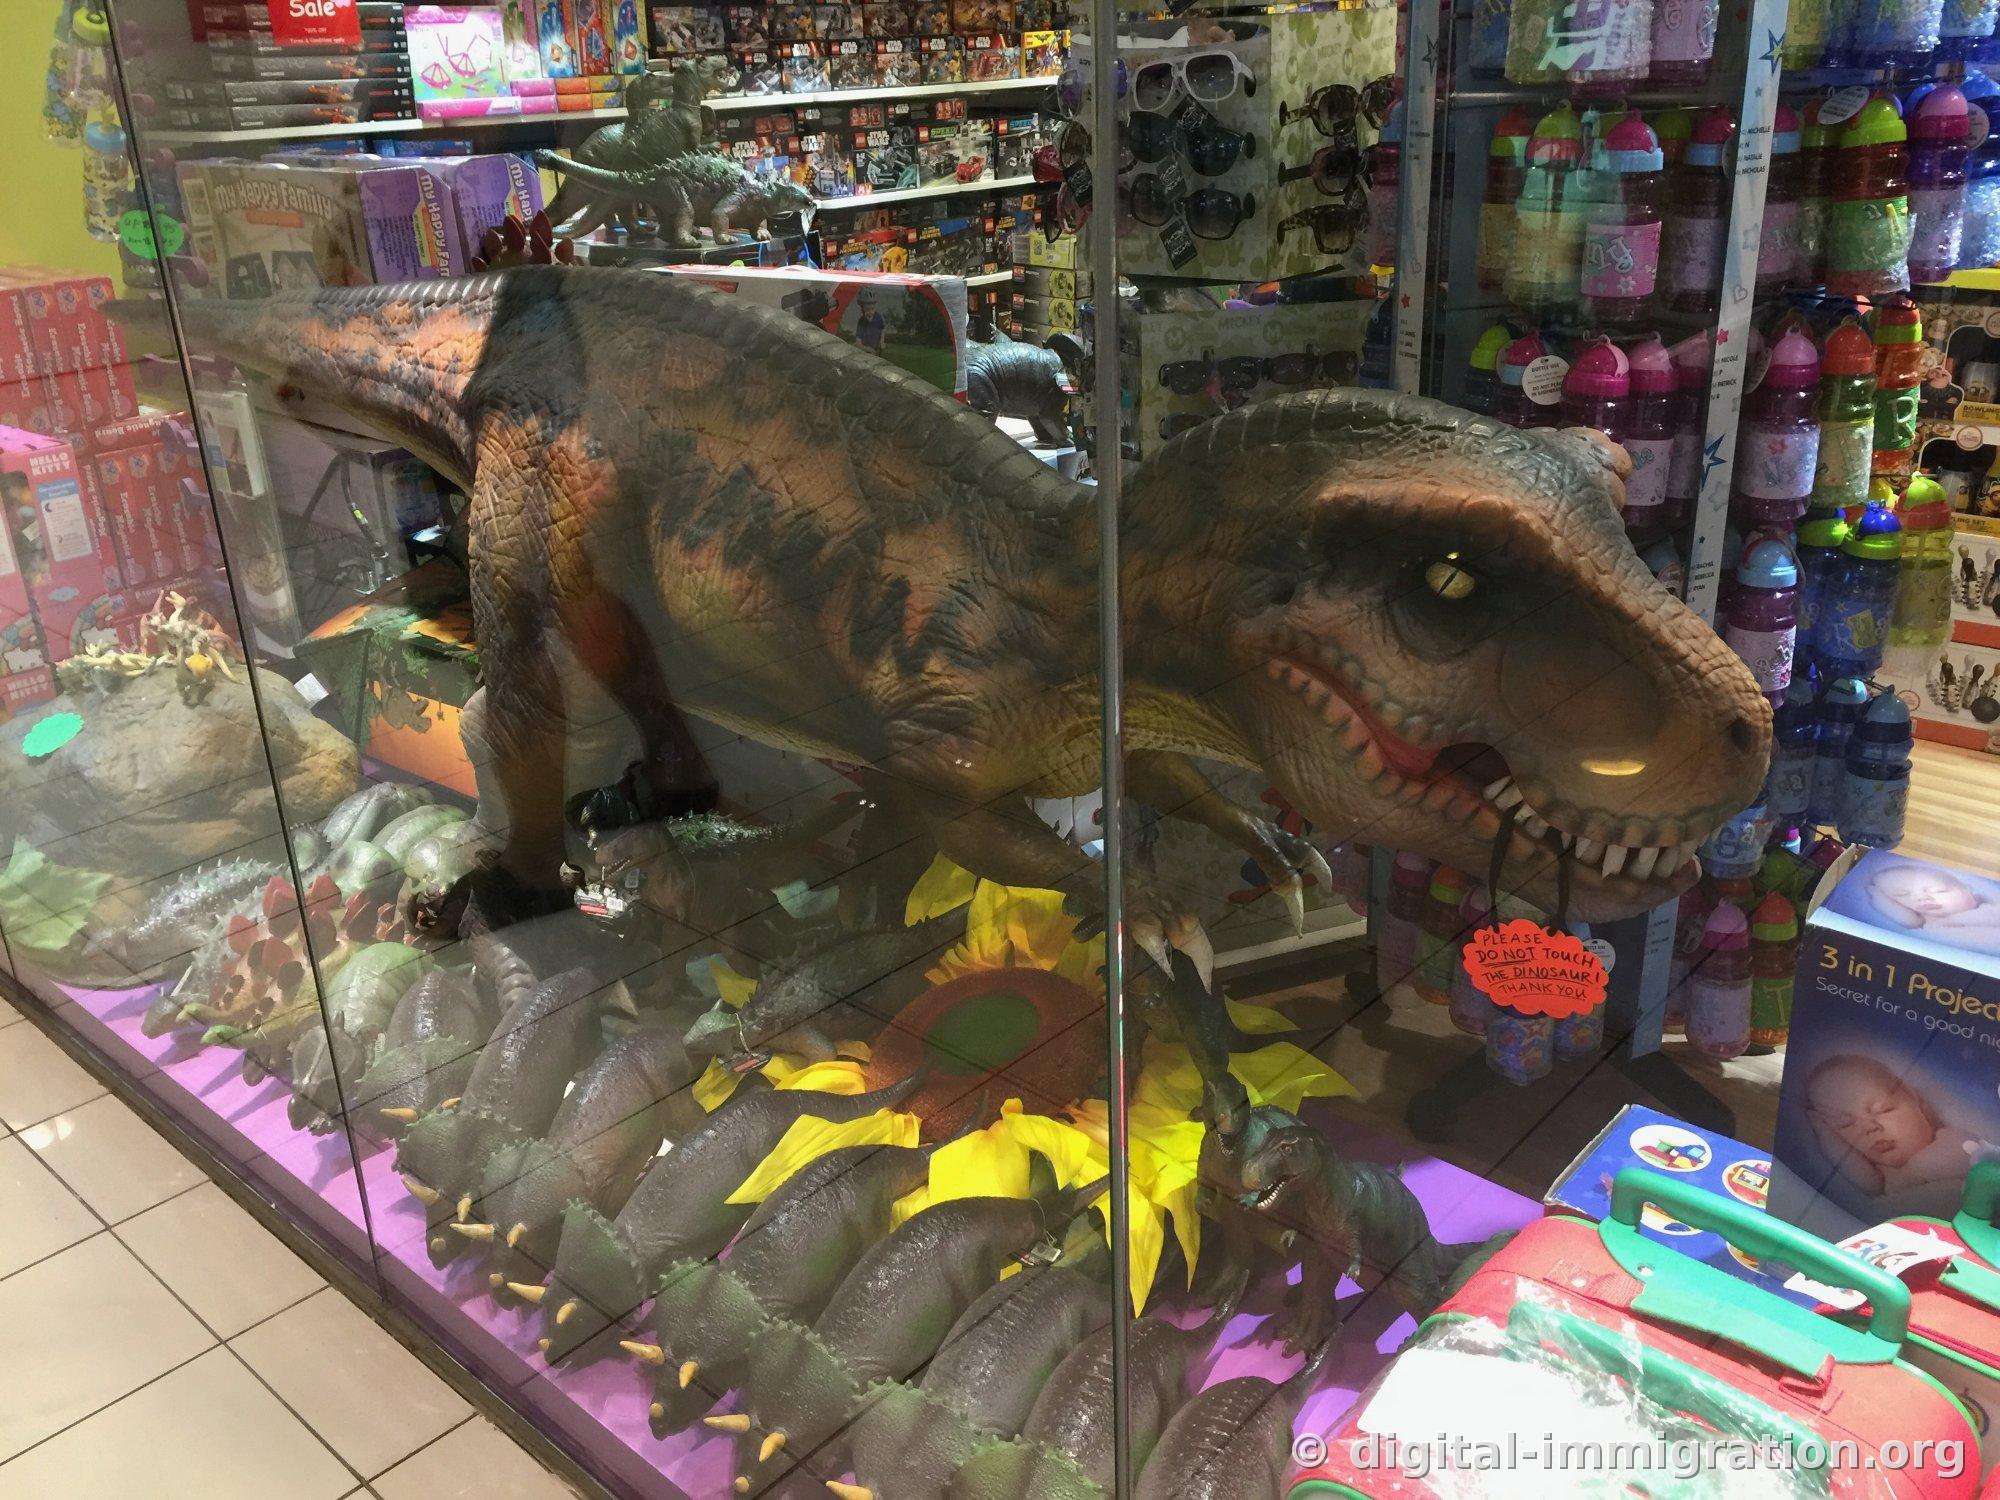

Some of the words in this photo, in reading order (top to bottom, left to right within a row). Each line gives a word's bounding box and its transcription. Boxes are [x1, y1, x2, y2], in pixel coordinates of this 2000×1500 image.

[289, 0, 336, 17] Sale
[867, 138, 890, 147] WARS
[869, 130, 888, 140] STAR
[734, 140, 756, 150] STAR
[1742, 165, 1766, 175] NICHOLAS
[238, 178, 280, 208] Happy
[279, 178, 334, 222] Family
[428, 201, 446, 248] Happy
[77, 322, 93, 368] Erasable
[106, 319, 121, 363] Erasable
[1963, 404, 2000, 415] BOWLING
[29, 451, 69, 467] HELLO
[31, 460, 71, 477] KITTY
[6, 674, 46, 691] HELLO
[9, 682, 49, 701] KITTY
[1482, 932, 1543, 946] PLEASE
[1475, 949, 1498, 963] DO
[1503, 946, 1536, 960] NOT
[1818, 943, 1839, 969] 3
[1847, 954, 1873, 982] in
[1885, 964, 1896, 989] 1
[1481, 968, 1509, 983] THE
[1498, 981, 1553, 994] THANK
[1557, 984, 1588, 999] YOU
[1815, 976, 1871, 1007] Secret
[1875, 996, 1901, 1015] for
[1905, 1009, 1918, 1022] a
[1923, 1015, 1976, 1039] good
